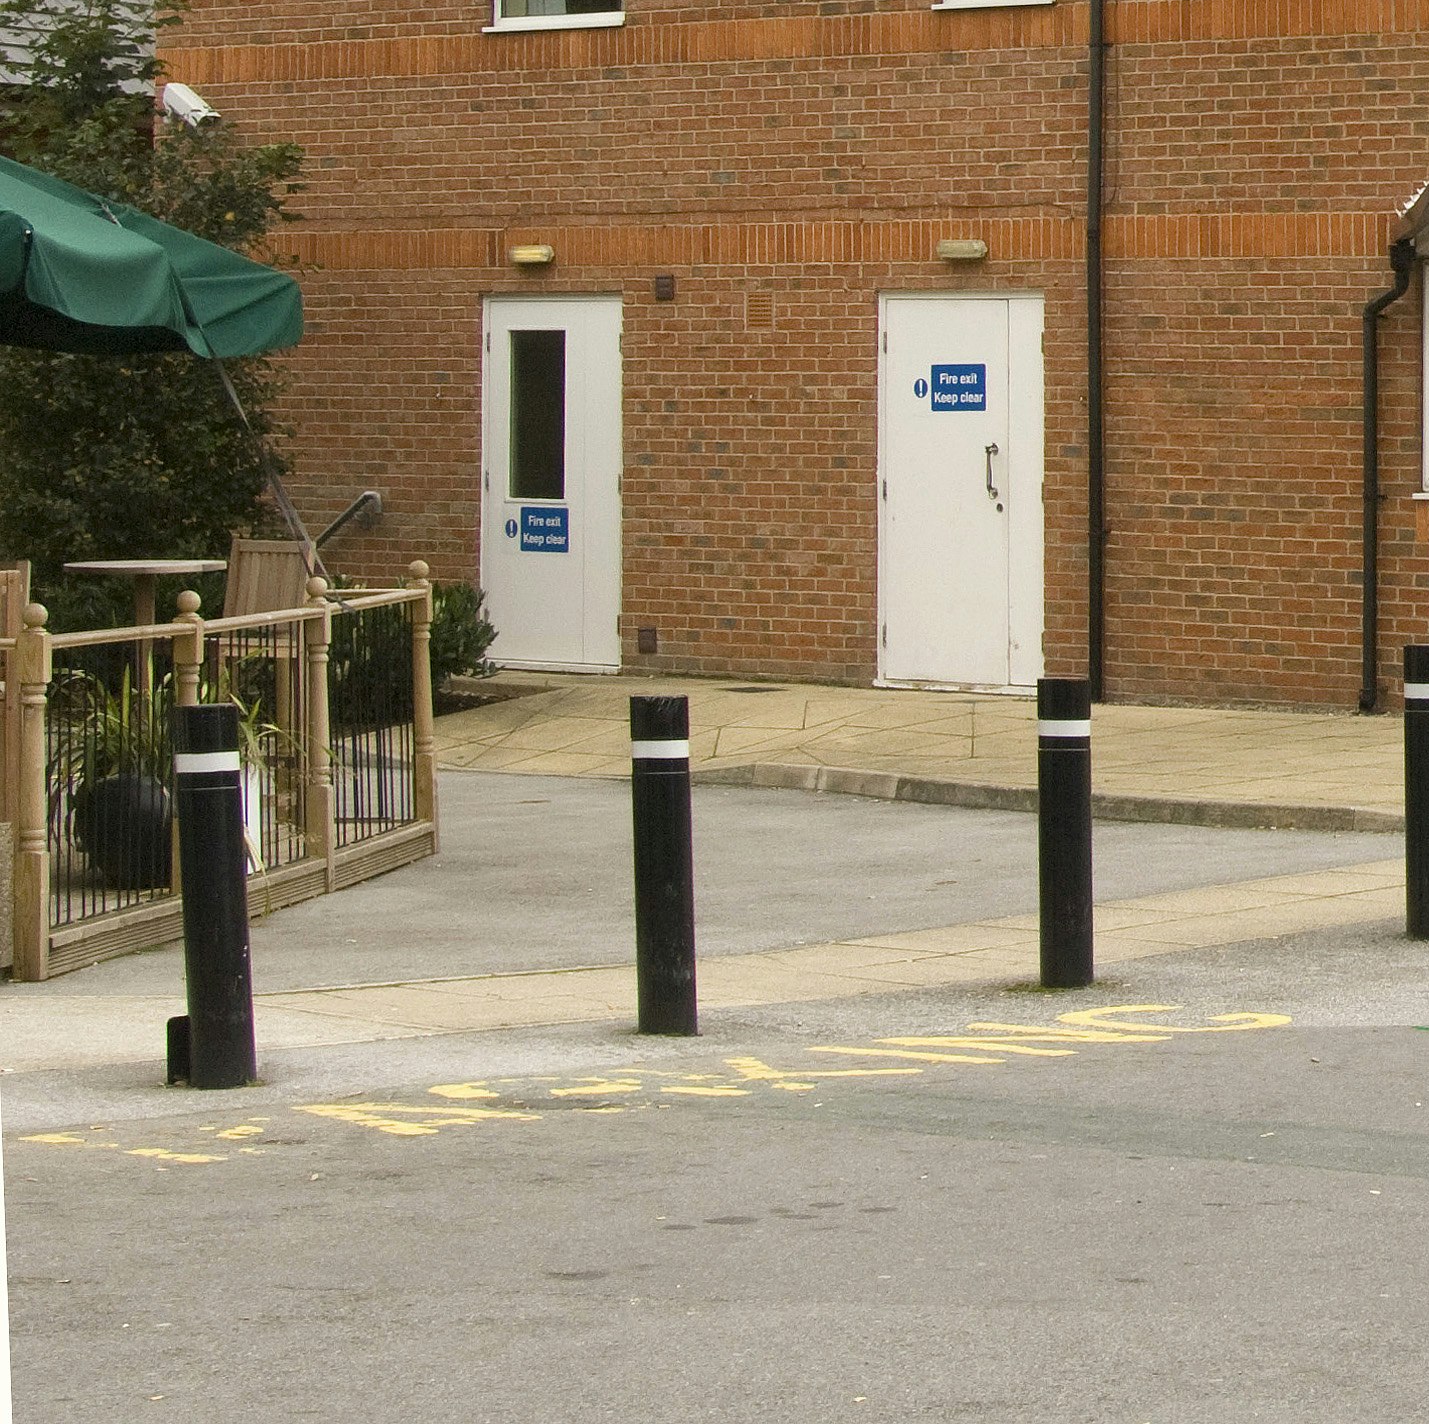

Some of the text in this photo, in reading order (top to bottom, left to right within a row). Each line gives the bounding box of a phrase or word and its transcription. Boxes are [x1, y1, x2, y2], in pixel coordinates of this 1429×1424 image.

[940, 372, 978, 384] Fire exit
[934, 391, 984, 406] Keep clear
[528, 515, 561, 527] Fire exit
[523, 532, 567, 546] Keep clear
